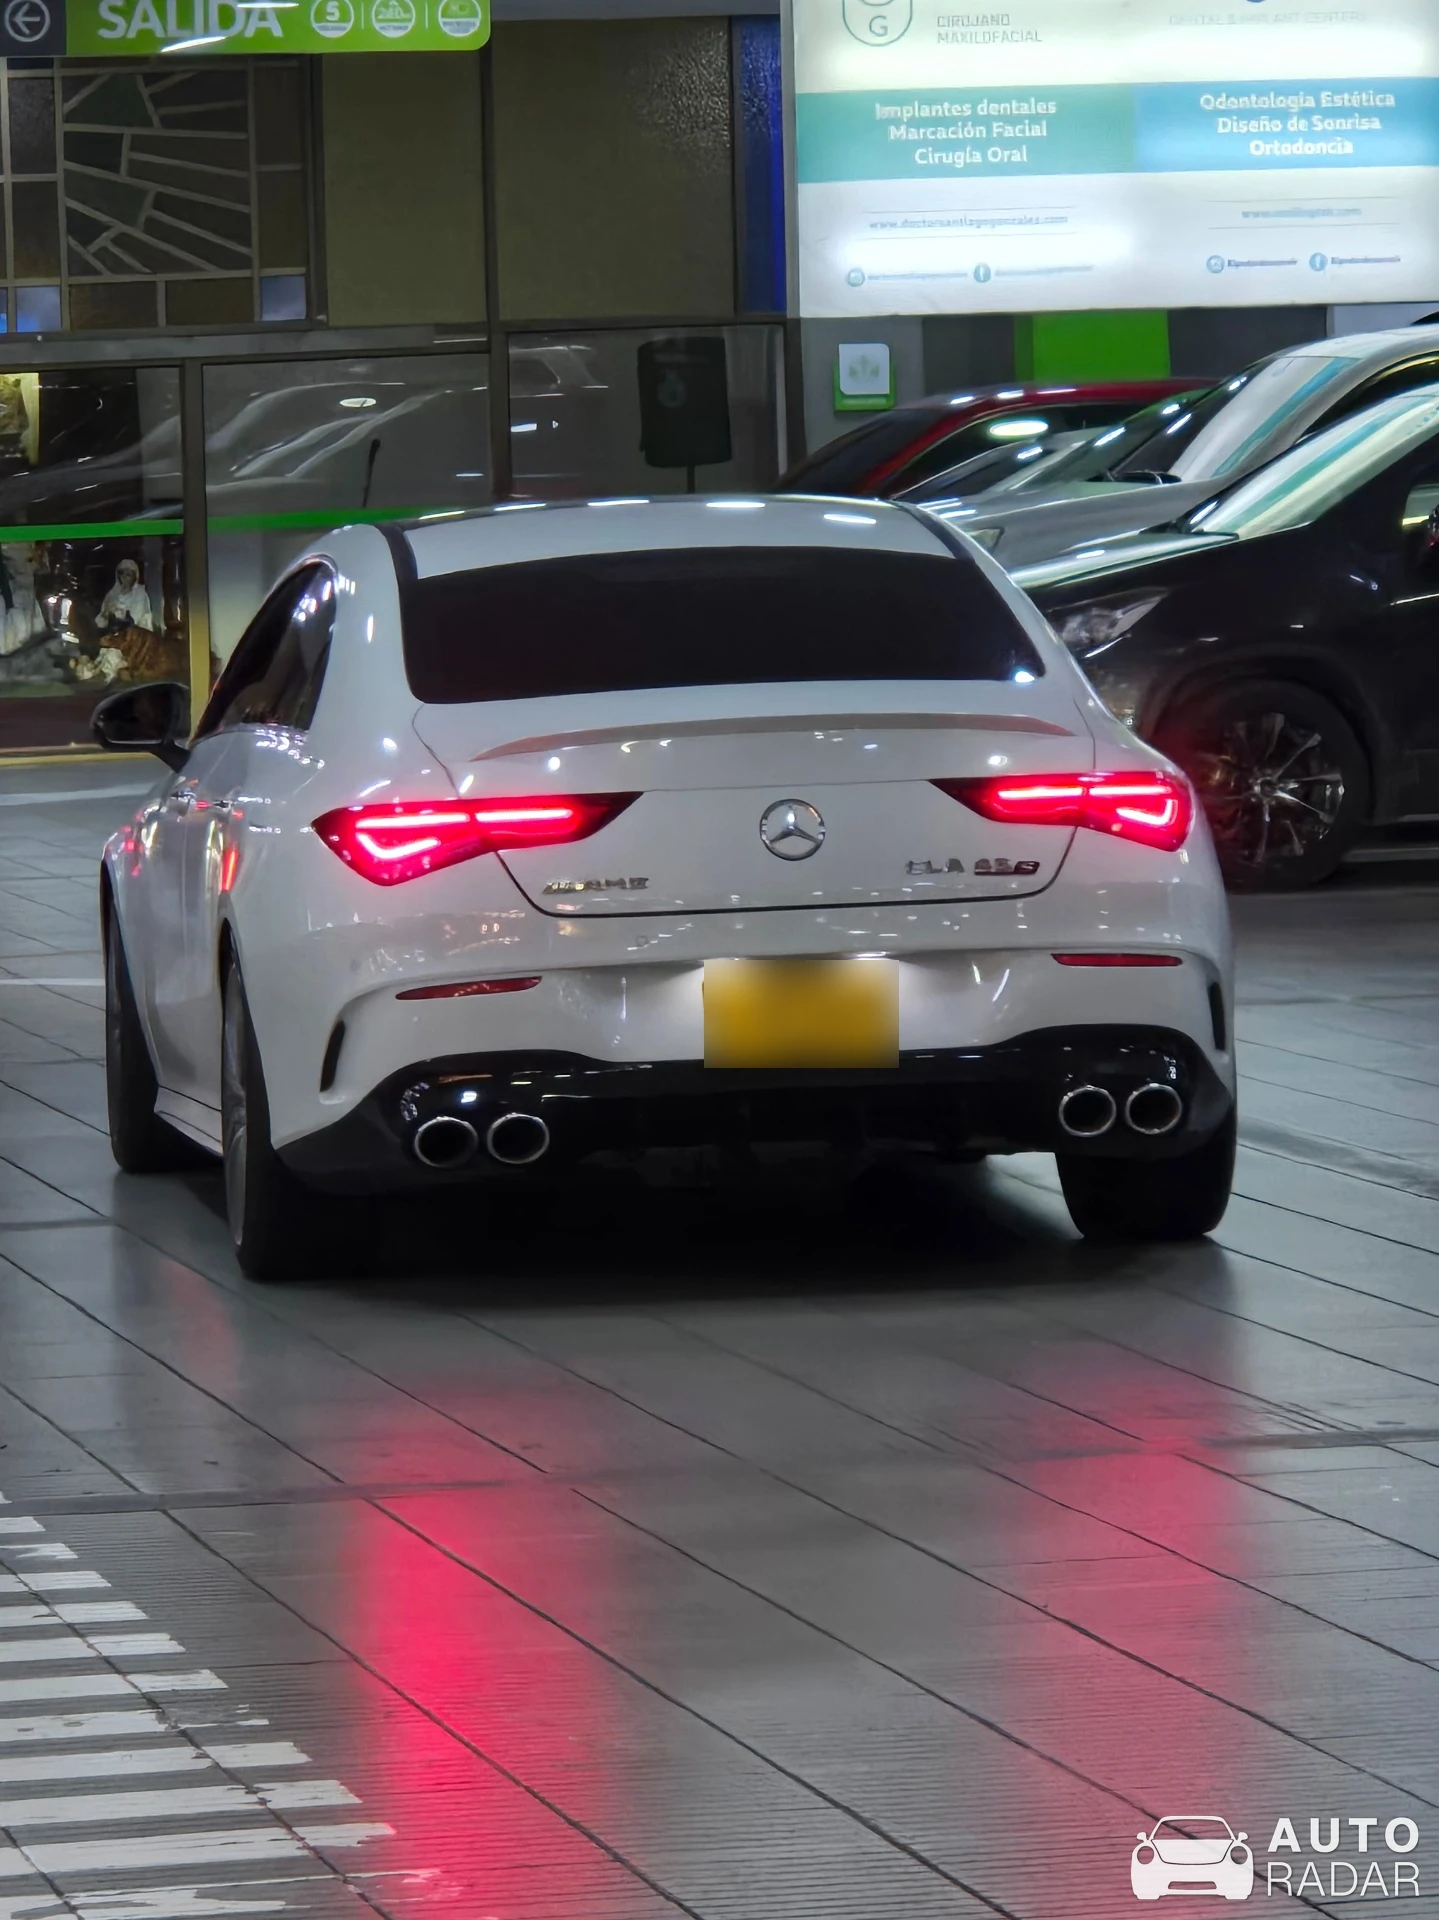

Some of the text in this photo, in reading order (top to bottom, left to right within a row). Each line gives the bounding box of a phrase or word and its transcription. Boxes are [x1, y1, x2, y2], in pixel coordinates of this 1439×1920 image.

[97, 0, 284, 39] SALIDA
[869, 15, 888, 37] G
[937, 13, 1011, 28] CIRUJANO
[937, 30, 1043, 44] MAXILOFACIAL
[1320, 89, 1396, 108] Estética
[875, 97, 1057, 121] Implantes dentales
[888, 120, 1048, 140] Marcación Facial
[1217, 113, 1382, 134] Diseño de Sonrisa
[987, 145, 1028, 163] Oral
[1249, 137, 1354, 156] Ortodoncia
